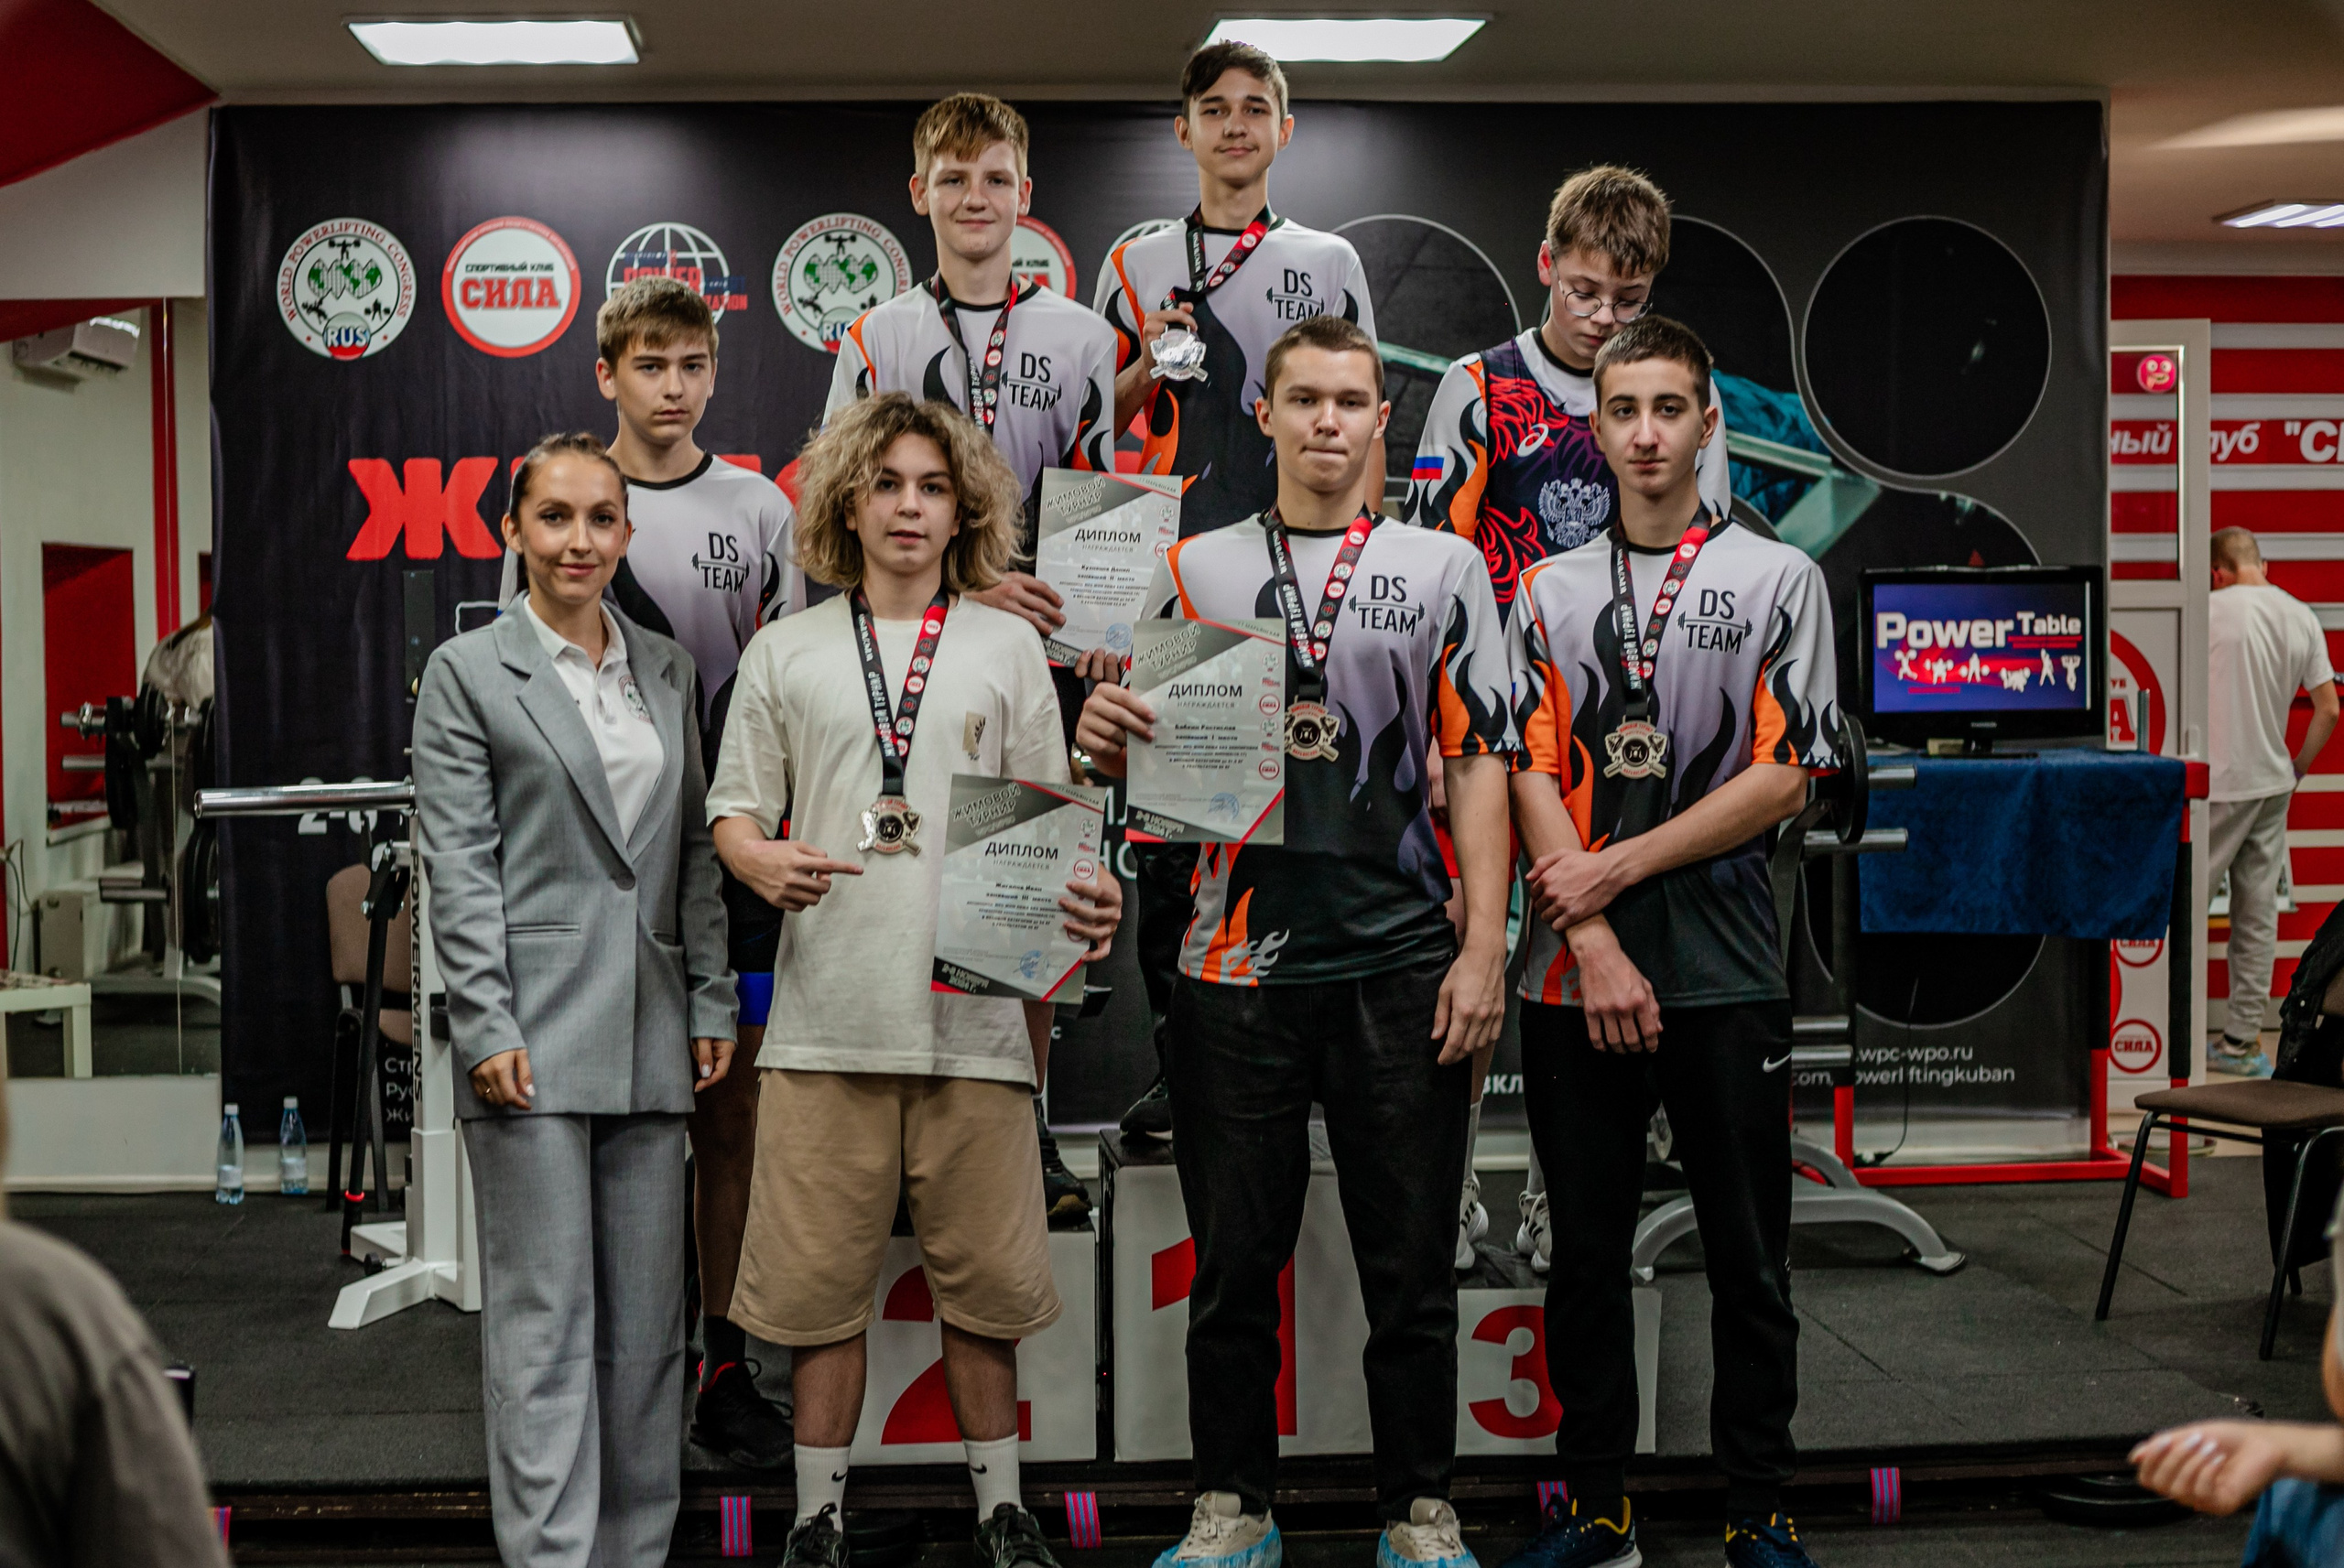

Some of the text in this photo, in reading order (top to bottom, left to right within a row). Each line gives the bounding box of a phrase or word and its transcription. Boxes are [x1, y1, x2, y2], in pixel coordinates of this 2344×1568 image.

[288, 222, 386, 264] POWERLIFTING
[387, 243, 413, 319] CONGRESS
[776, 262, 792, 317] WORLD
[784, 216, 882, 258] POWERLIFTING
[1284, 268, 1313, 297] DS
[281, 267, 298, 323] WORLD
[461, 276, 561, 310] СИЛА
[1274, 298, 1322, 320] TEAM
[327, 327, 367, 348] RUS
[1020, 351, 1052, 384] DS
[1008, 384, 1057, 412] TEAM
[709, 532, 739, 563] DS
[1075, 527, 1141, 544] ДИПЛОМ
[700, 566, 744, 595] TEAM
[1371, 574, 1407, 603] DS
[1698, 589, 1735, 621] DS
[1358, 607, 1418, 638] TEAM
[1877, 611, 2082, 650] Power Table
[1136, 621, 1202, 667] ЖИМОВОЙ
[1686, 623, 1743, 655] TEAM
[1168, 684, 1243, 699] ДИПЛОМ
[951, 781, 1021, 822] ЖИМОВОЙ
[985, 841, 1058, 860] ДИПЛОМ
[411, 849, 422, 1103] POWERMENS
[2114, 1040, 2154, 1053] СИЛА
[1469, 1303, 1564, 1440] 3
